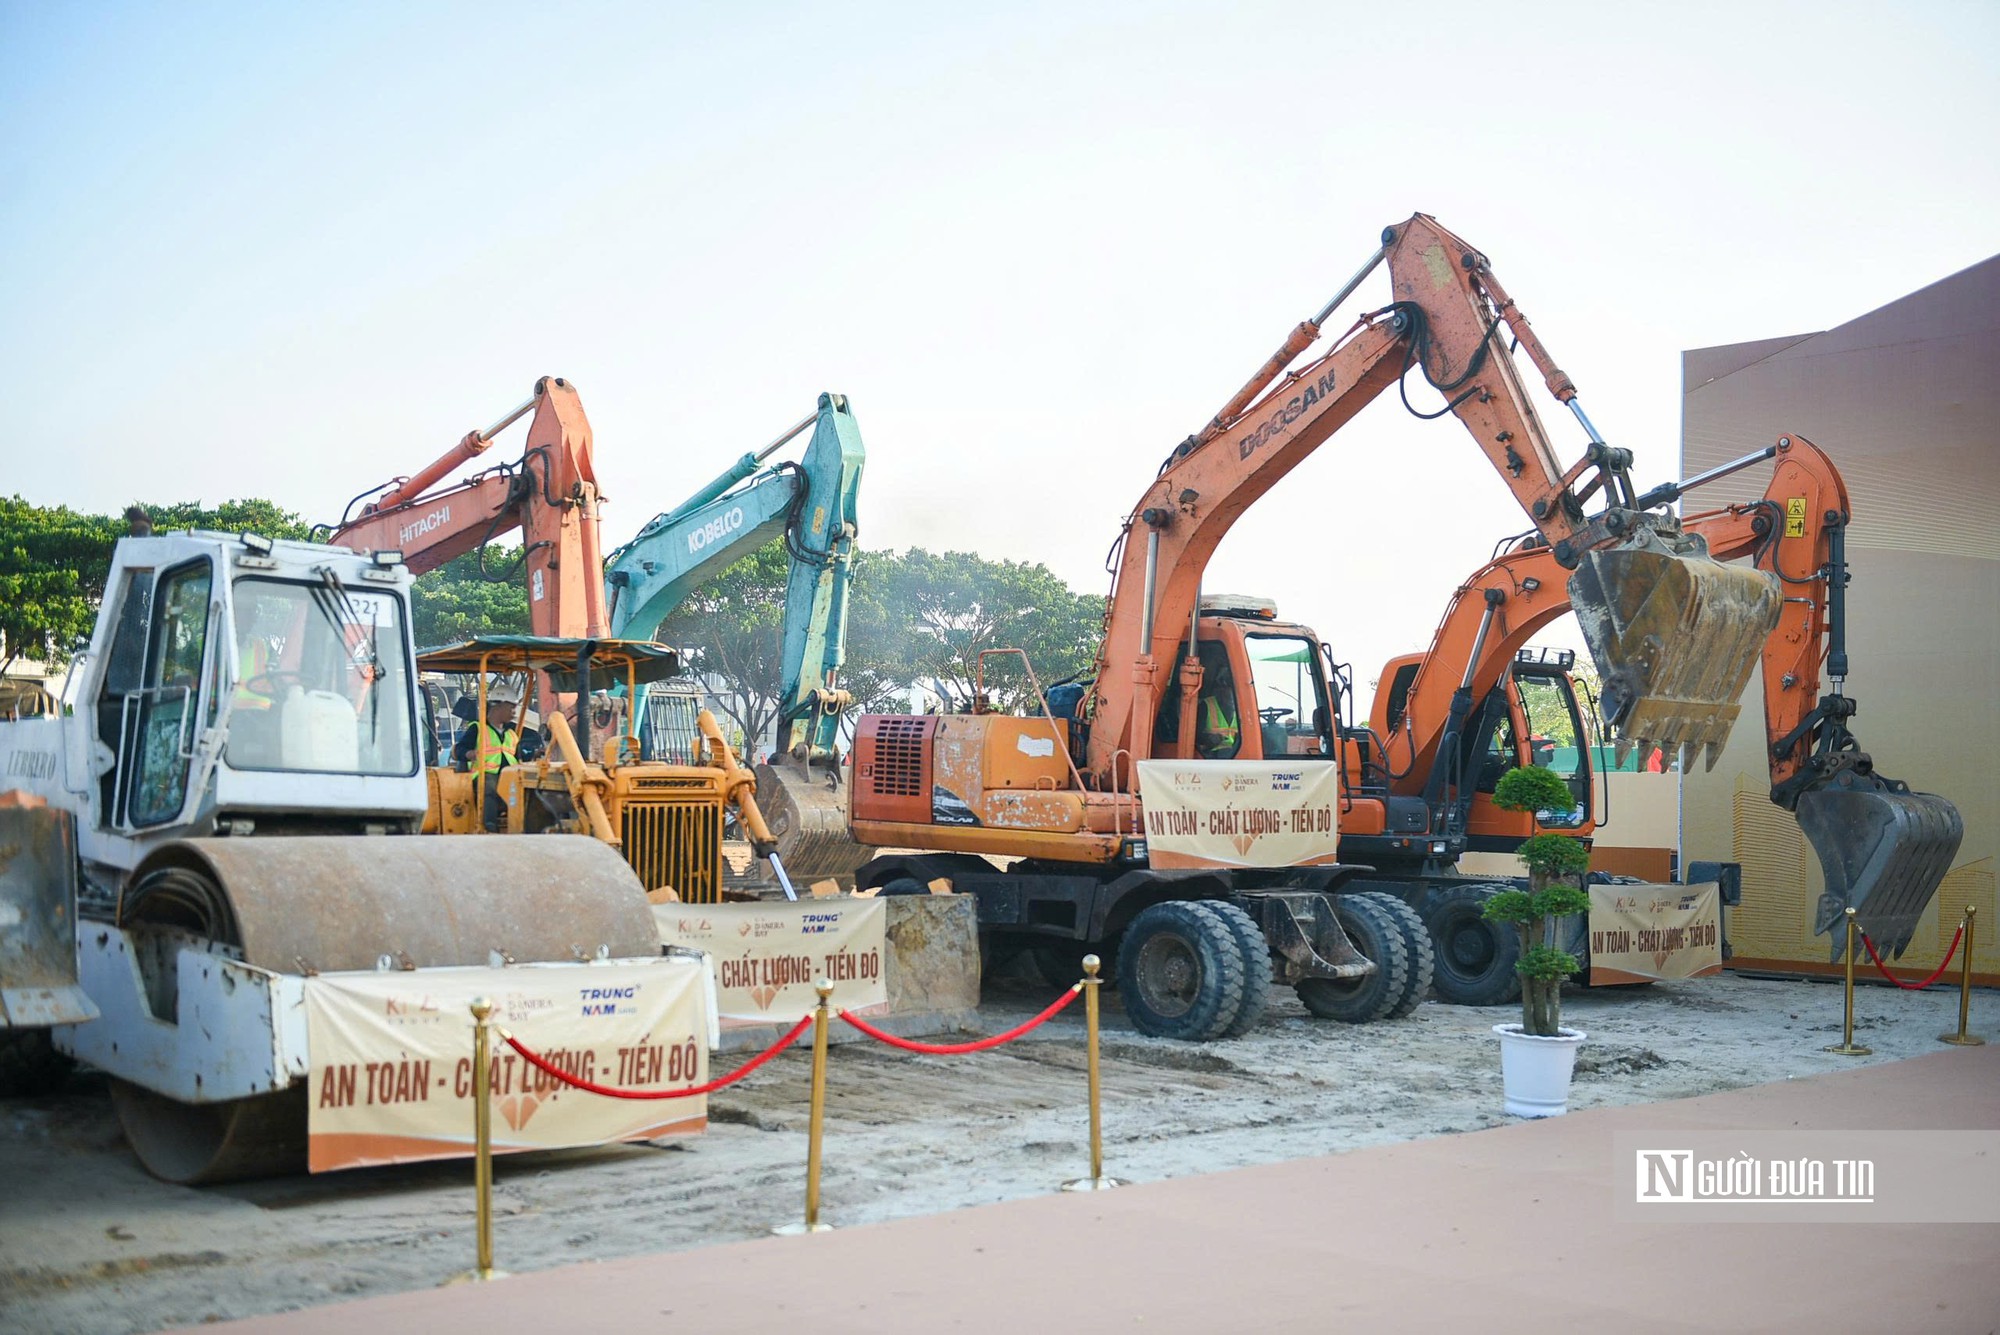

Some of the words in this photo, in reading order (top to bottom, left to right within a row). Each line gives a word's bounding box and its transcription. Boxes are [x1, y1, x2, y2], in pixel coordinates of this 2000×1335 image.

[1240, 367, 1335, 461] DOOSAN
[400, 506, 450, 545] HITACHI
[687, 507, 743, 554] KOBELCO
[1167, 806, 1197, 835] TOÀN
[1209, 802, 1239, 835] CHẤT
[1243, 806, 1280, 839] LƯỢNG
[1291, 802, 1314, 834] TIẾN
[1317, 804, 1331, 837] ĐỘ
[801, 925, 825, 934] NAM
[802, 914, 838, 923] TRUNG
[1592, 931, 1604, 954] AN
[1606, 926, 1630, 953] TOÀN
[1638, 922, 1660, 952] CHẤT
[1705, 919, 1716, 950] ĐỘ
[722, 949, 758, 989] CHẤT
[763, 955, 811, 991] LƯỢNG
[825, 945, 856, 982] TIẾN
[860, 947, 879, 984] ĐỘ
[580, 987, 634, 1000] TRUNG
[582, 1004, 616, 1016] NAM
[320, 1062, 357, 1109] AN
[366, 1051, 431, 1105] TOÀN
[617, 1034, 661, 1086] TIẾN
[668, 1035, 699, 1088] ĐỘ
